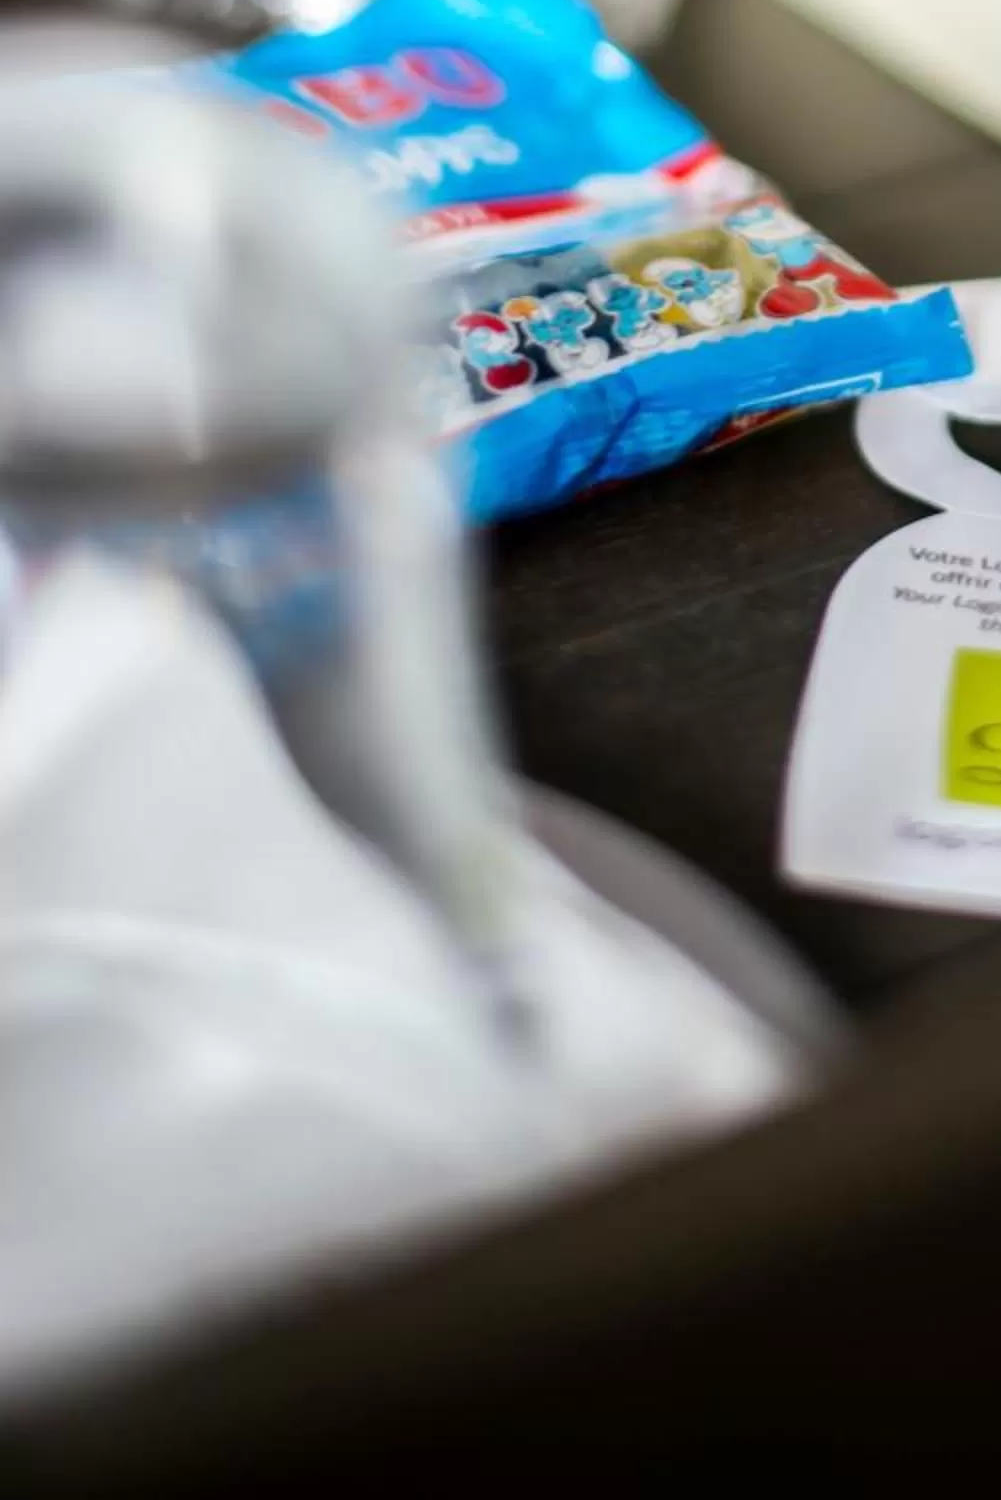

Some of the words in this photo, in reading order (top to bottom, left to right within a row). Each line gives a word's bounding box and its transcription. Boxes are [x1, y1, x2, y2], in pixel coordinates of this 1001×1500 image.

[908, 545, 973, 567] Votre
[929, 570, 992, 590] offrir
[893, 585, 945, 605] Your
